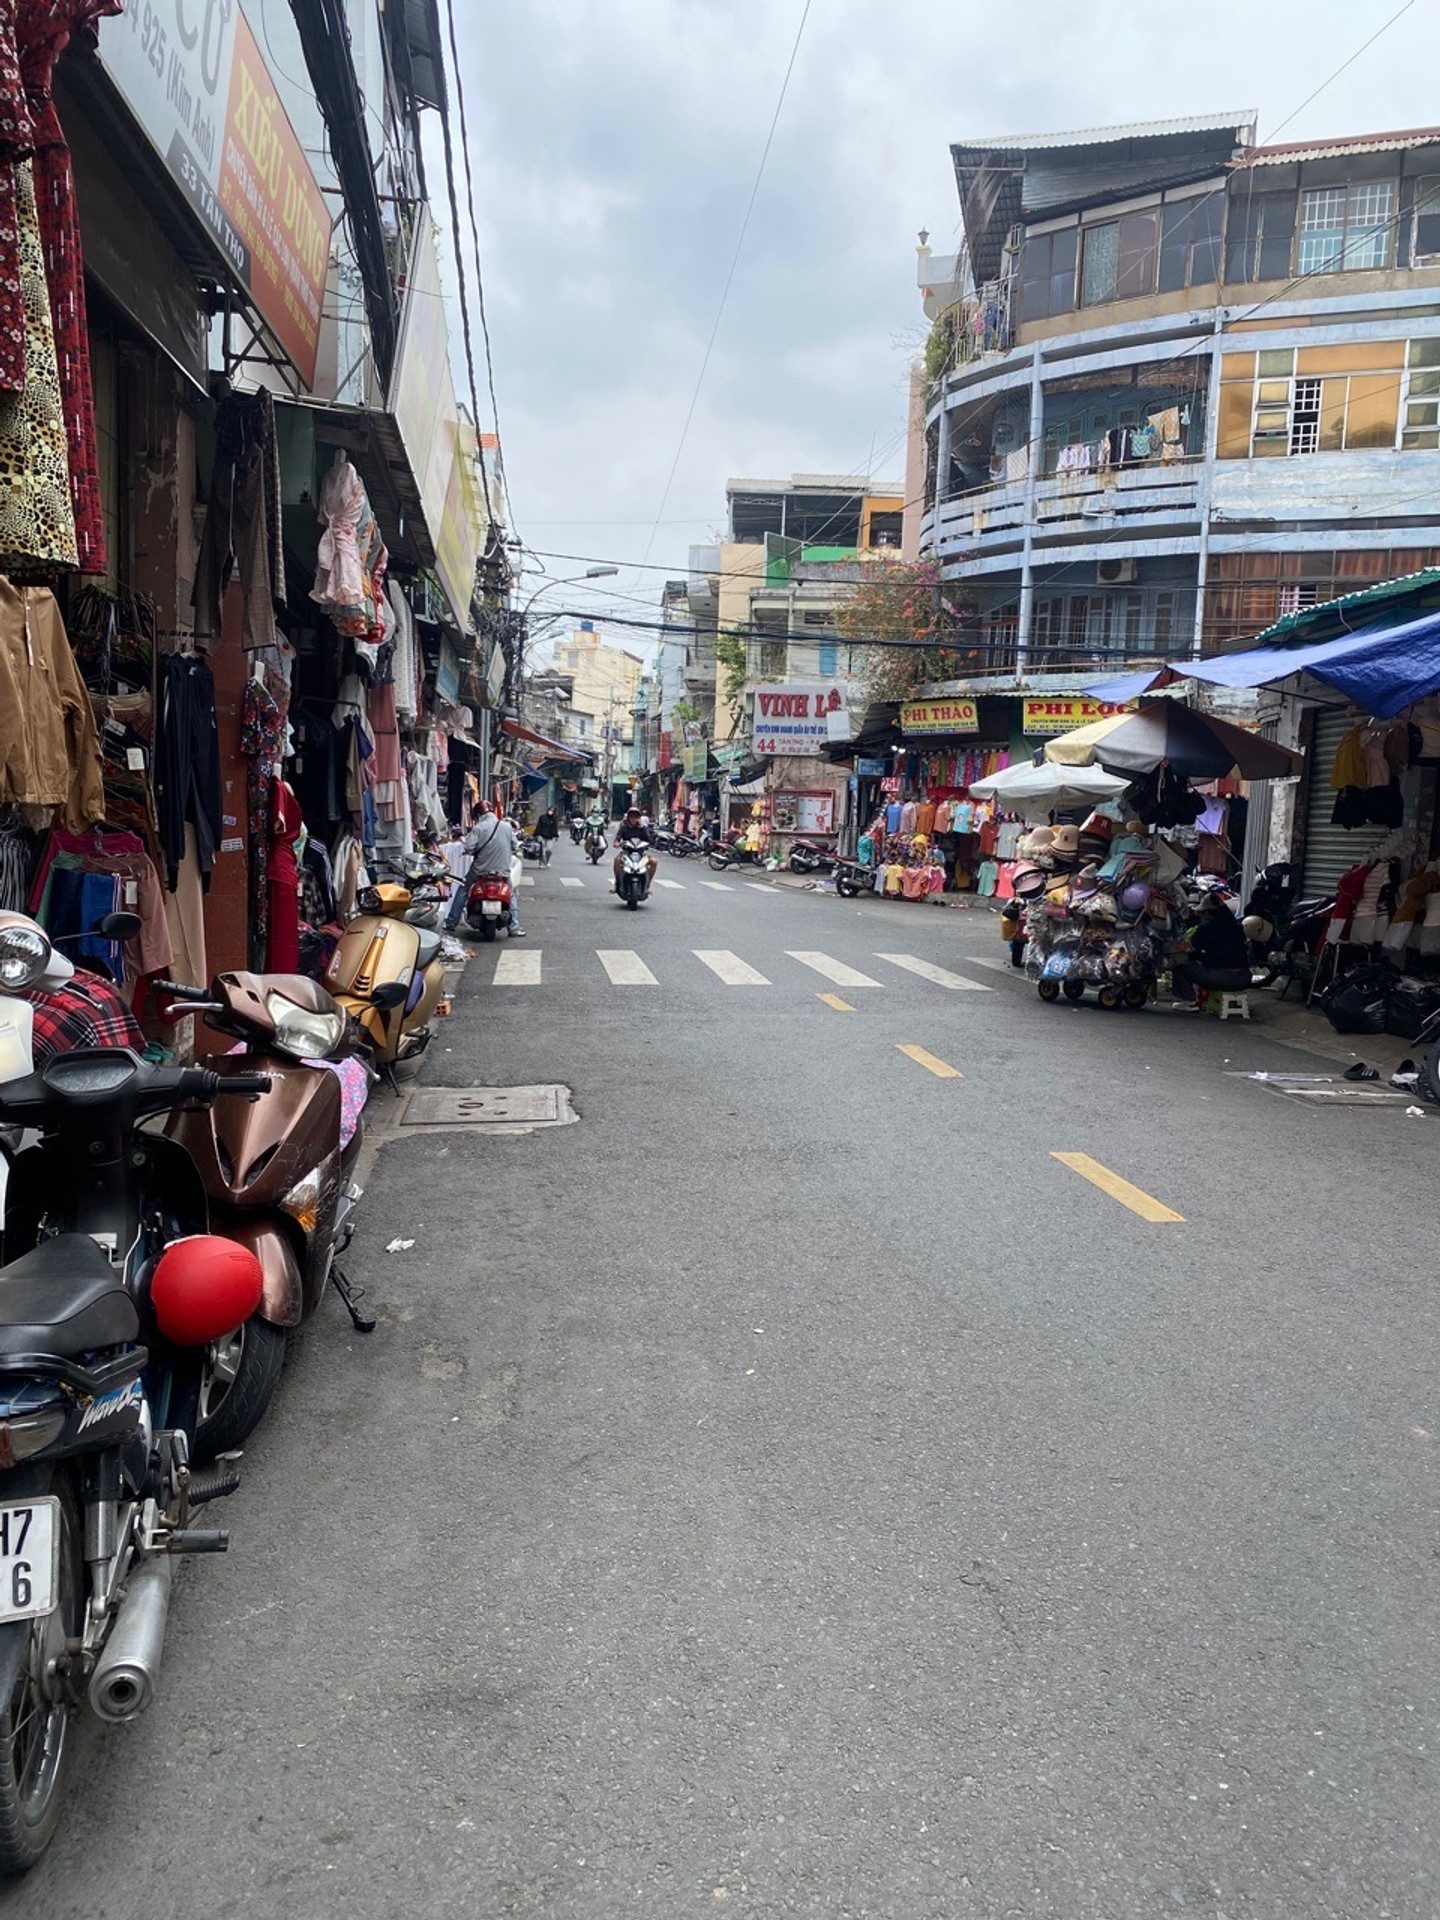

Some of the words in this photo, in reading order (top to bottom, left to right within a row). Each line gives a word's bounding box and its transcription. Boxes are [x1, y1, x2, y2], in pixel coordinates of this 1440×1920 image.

[141, 1, 167, 78] 925
[167, 47, 192, 128] (Kim
[180, 152, 198, 192] 33
[200, 184, 222, 233] TÂN
[223, 222, 245, 271] THỌ
[758, 693, 809, 717] VINH
[815, 688, 841, 718] LÊ
[903, 708, 928, 722] PHI
[930, 701, 973, 720] THẢO
[1028, 703, 1073, 715] PHI
[757, 738, 776, 752] 44
[12, 1561, 32, 1608] 6
